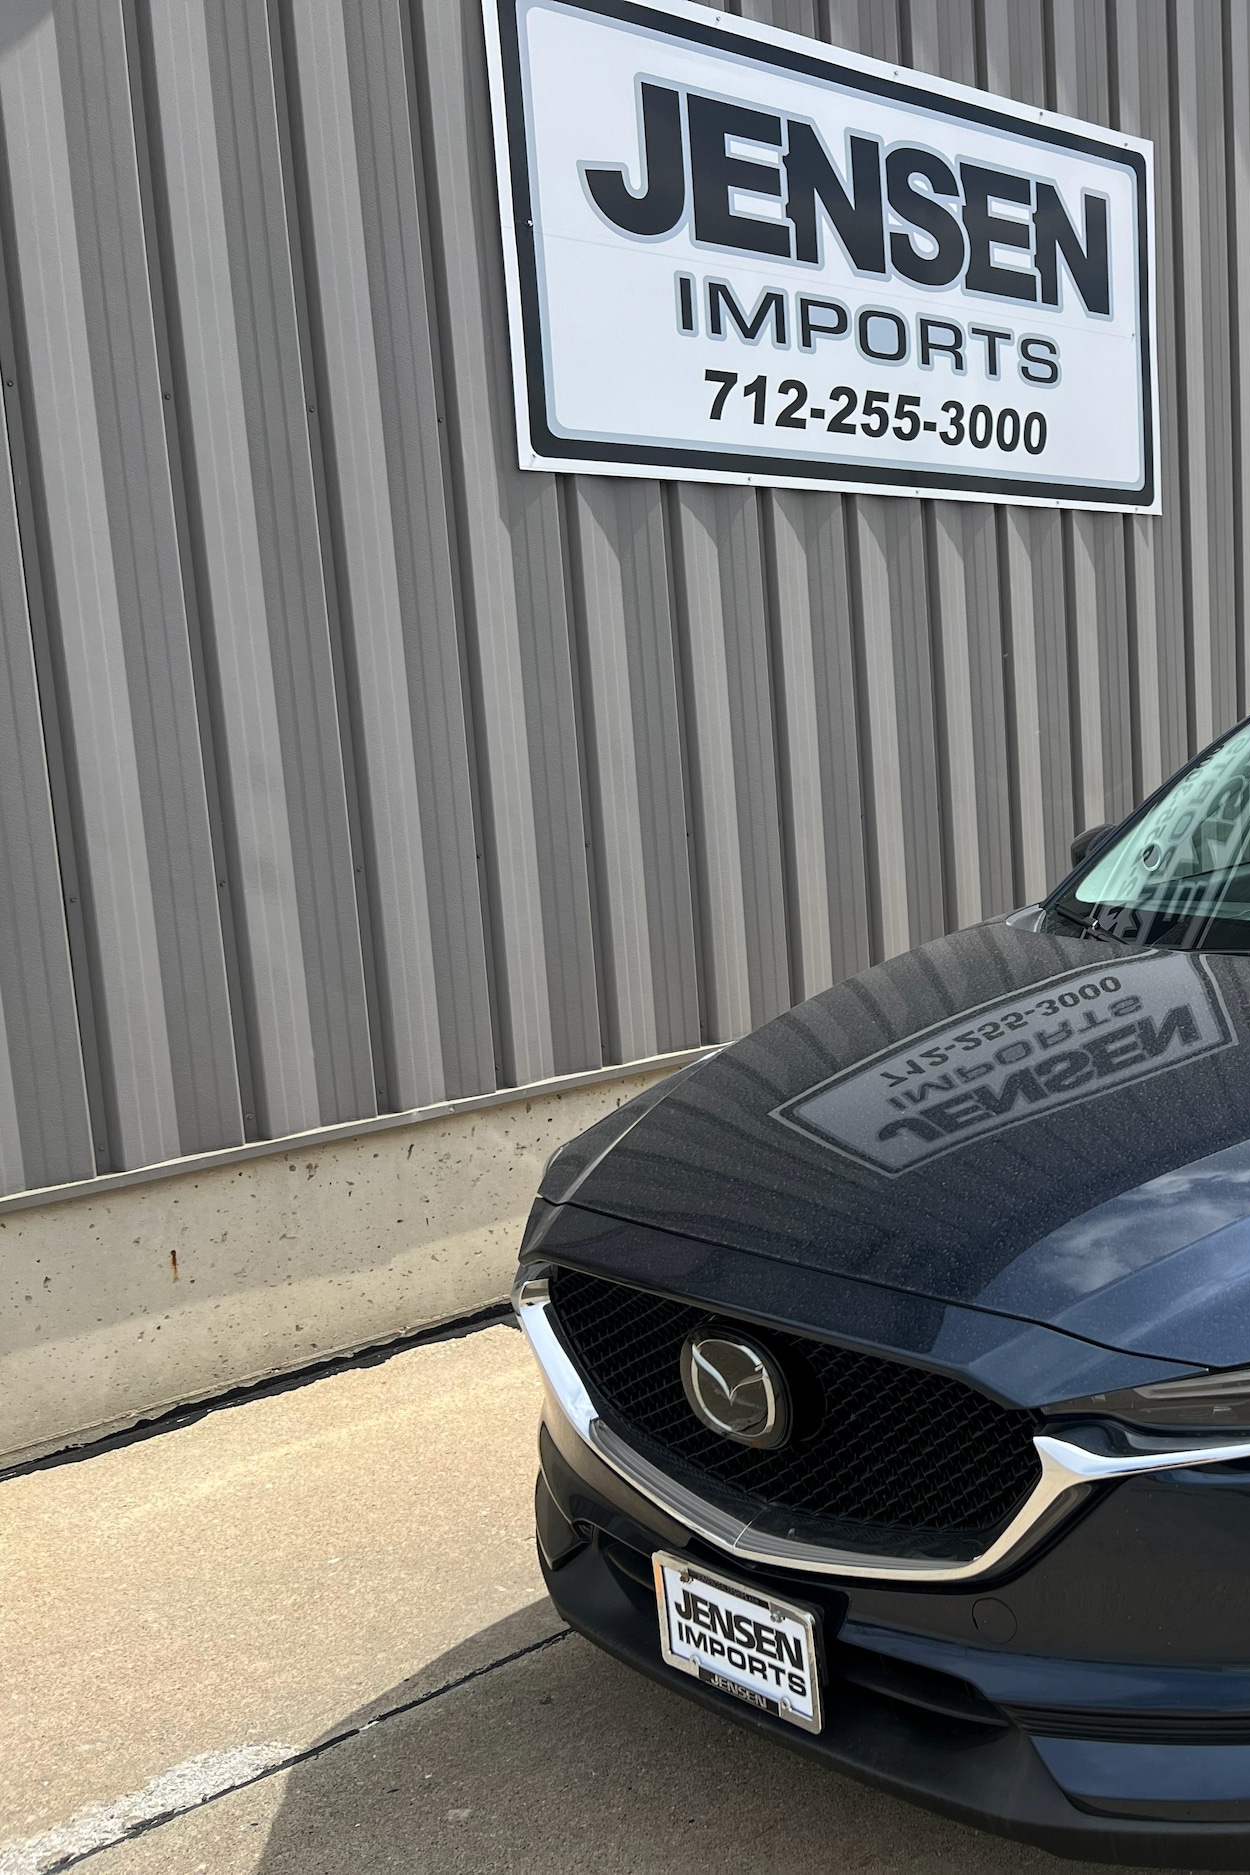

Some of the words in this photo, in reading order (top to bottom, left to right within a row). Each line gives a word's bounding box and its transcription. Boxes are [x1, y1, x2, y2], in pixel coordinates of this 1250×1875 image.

[580, 76, 1112, 318] JENSEN
[678, 274, 1060, 386] IMPORTS
[704, 368, 1048, 456] 712-255-3000
[674, 1588, 804, 1671] JENSEN
[677, 1621, 807, 1697] IMPORTS
[711, 1673, 768, 1709] JENSEN
